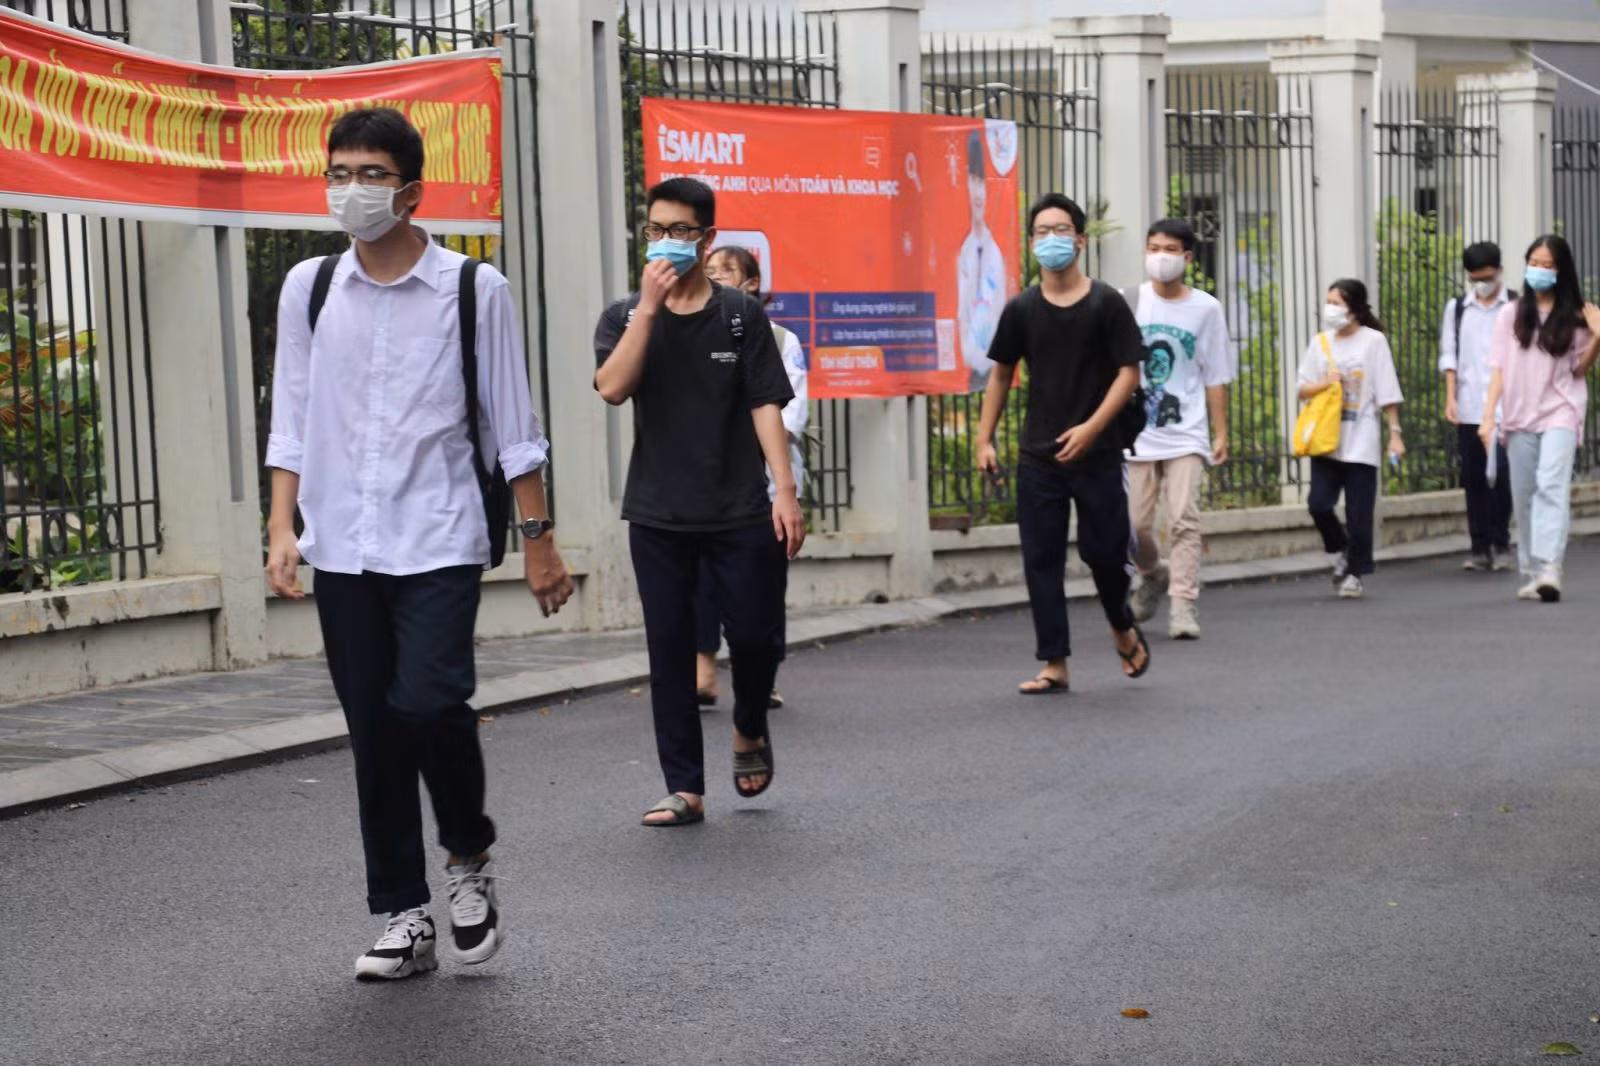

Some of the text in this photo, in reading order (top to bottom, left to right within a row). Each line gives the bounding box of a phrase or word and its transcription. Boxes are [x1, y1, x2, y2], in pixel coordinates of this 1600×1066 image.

[34, 48, 80, 157] VỚI
[81, 61, 155, 164] THIÊN
[150, 72, 227, 170] NHIÊN
[458, 102, 491, 204] HỌC
[658, 123, 745, 166] iSMART
[723, 175, 747, 192] ANH
[749, 175, 772, 195] QUA
[774, 173, 799, 192] MÔN
[800, 173, 829, 194] TOÁN
[831, 175, 846, 194] VÀ
[847, 178, 876, 195] KHOA
